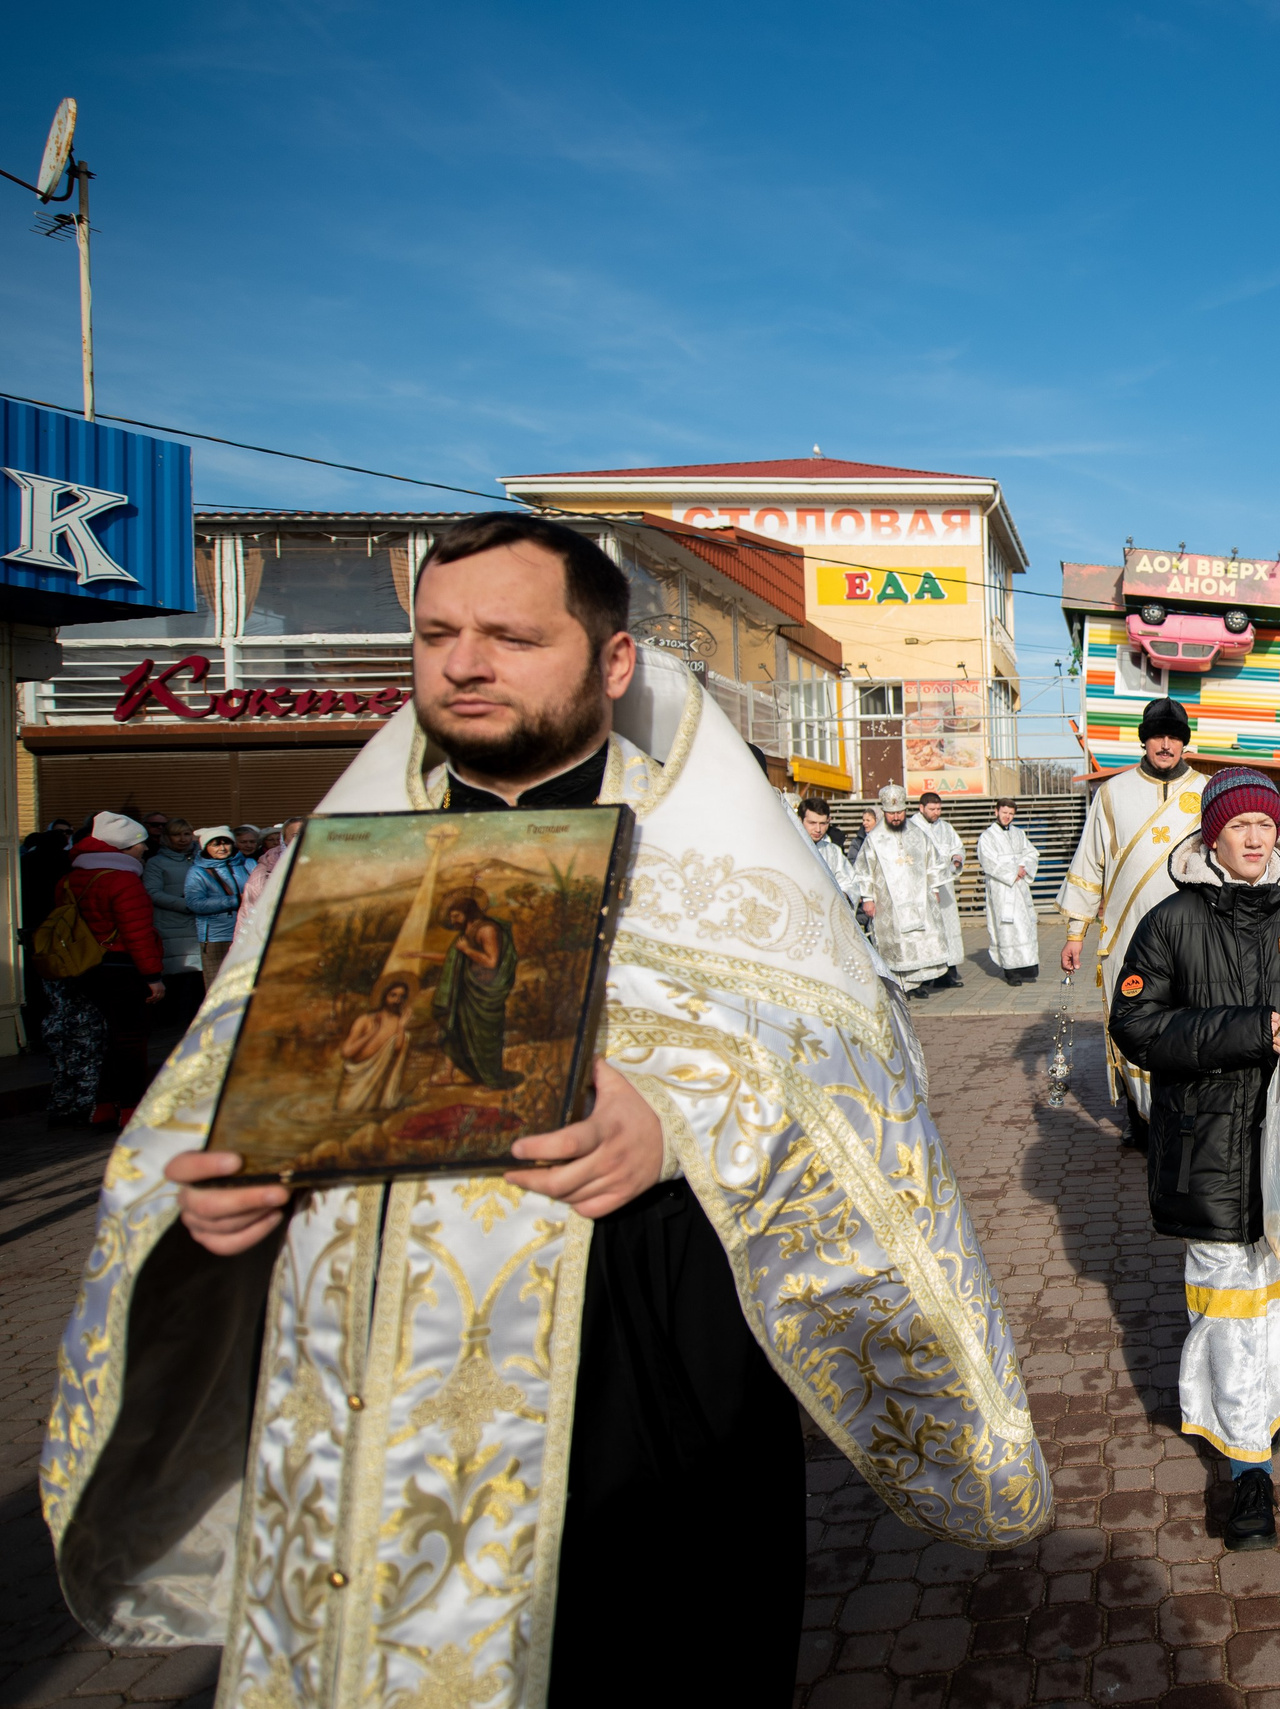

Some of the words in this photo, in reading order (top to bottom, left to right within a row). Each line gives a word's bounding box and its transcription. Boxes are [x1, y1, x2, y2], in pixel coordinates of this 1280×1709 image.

[682, 506, 971, 541] СТОЛОВАЯ
[1136, 554, 1189, 575] ДОМ
[1197, 559, 1270, 581] ВВЕРХ
[844, 571, 947, 604] ЕДА
[1166, 576, 1236, 597] ДНОМ
[113, 655, 411, 722] Кокте
[905, 684, 979, 694] СТОЛОВАЯ
[922, 778, 968, 791] ЕДА
